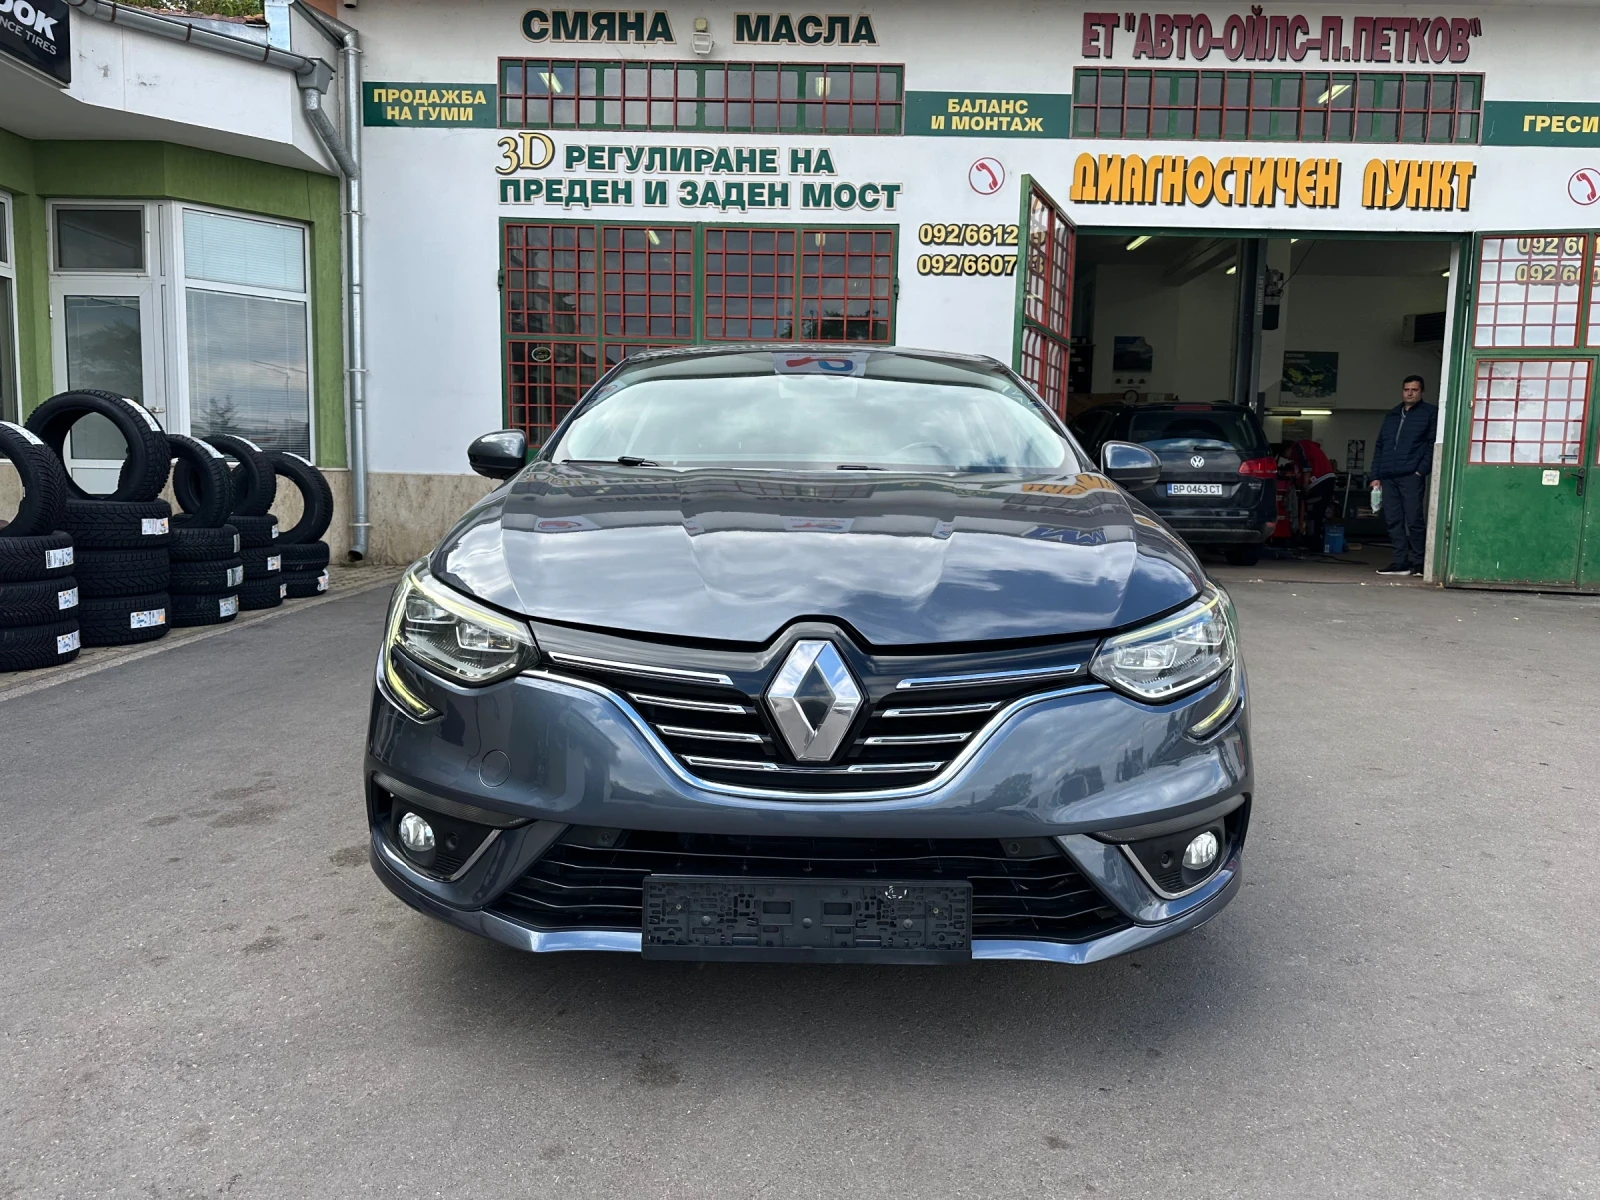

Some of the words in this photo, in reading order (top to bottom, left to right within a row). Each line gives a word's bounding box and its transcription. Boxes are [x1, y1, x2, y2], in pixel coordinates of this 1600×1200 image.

[522, 10, 675, 43] СМЯНА
[734, 12, 877, 45] МАСЛА
[1082, 13, 1118, 57] ЕТ
[25, 30, 57, 55] TIRES
[373, 89, 486, 105] ПРОДАЖБА
[947, 98, 1029, 114] БАЛАНС
[386, 106, 413, 121] НА
[419, 106, 473, 121] ГУМИ
[931, 115, 944, 130] И
[952, 116, 1043, 132] МОНТАЖ
[1523, 115, 1599, 133] ГРЕСИ
[496, 132, 555, 175] 3D
[565, 147, 777, 173] РЕГУЛИРАНЕ
[790, 149, 835, 173] НА
[1070, 153, 1341, 209] ДИАГНОСТИЧЕН
[1361, 159, 1476, 211] ПУНКТ
[499, 180, 632, 208] ПРЕДЕН
[645, 182, 667, 205] И
[679, 183, 789, 211] ЗАДЕН
[802, 184, 902, 209] МОСТ
[1186, 485, 1208, 494] 0463
